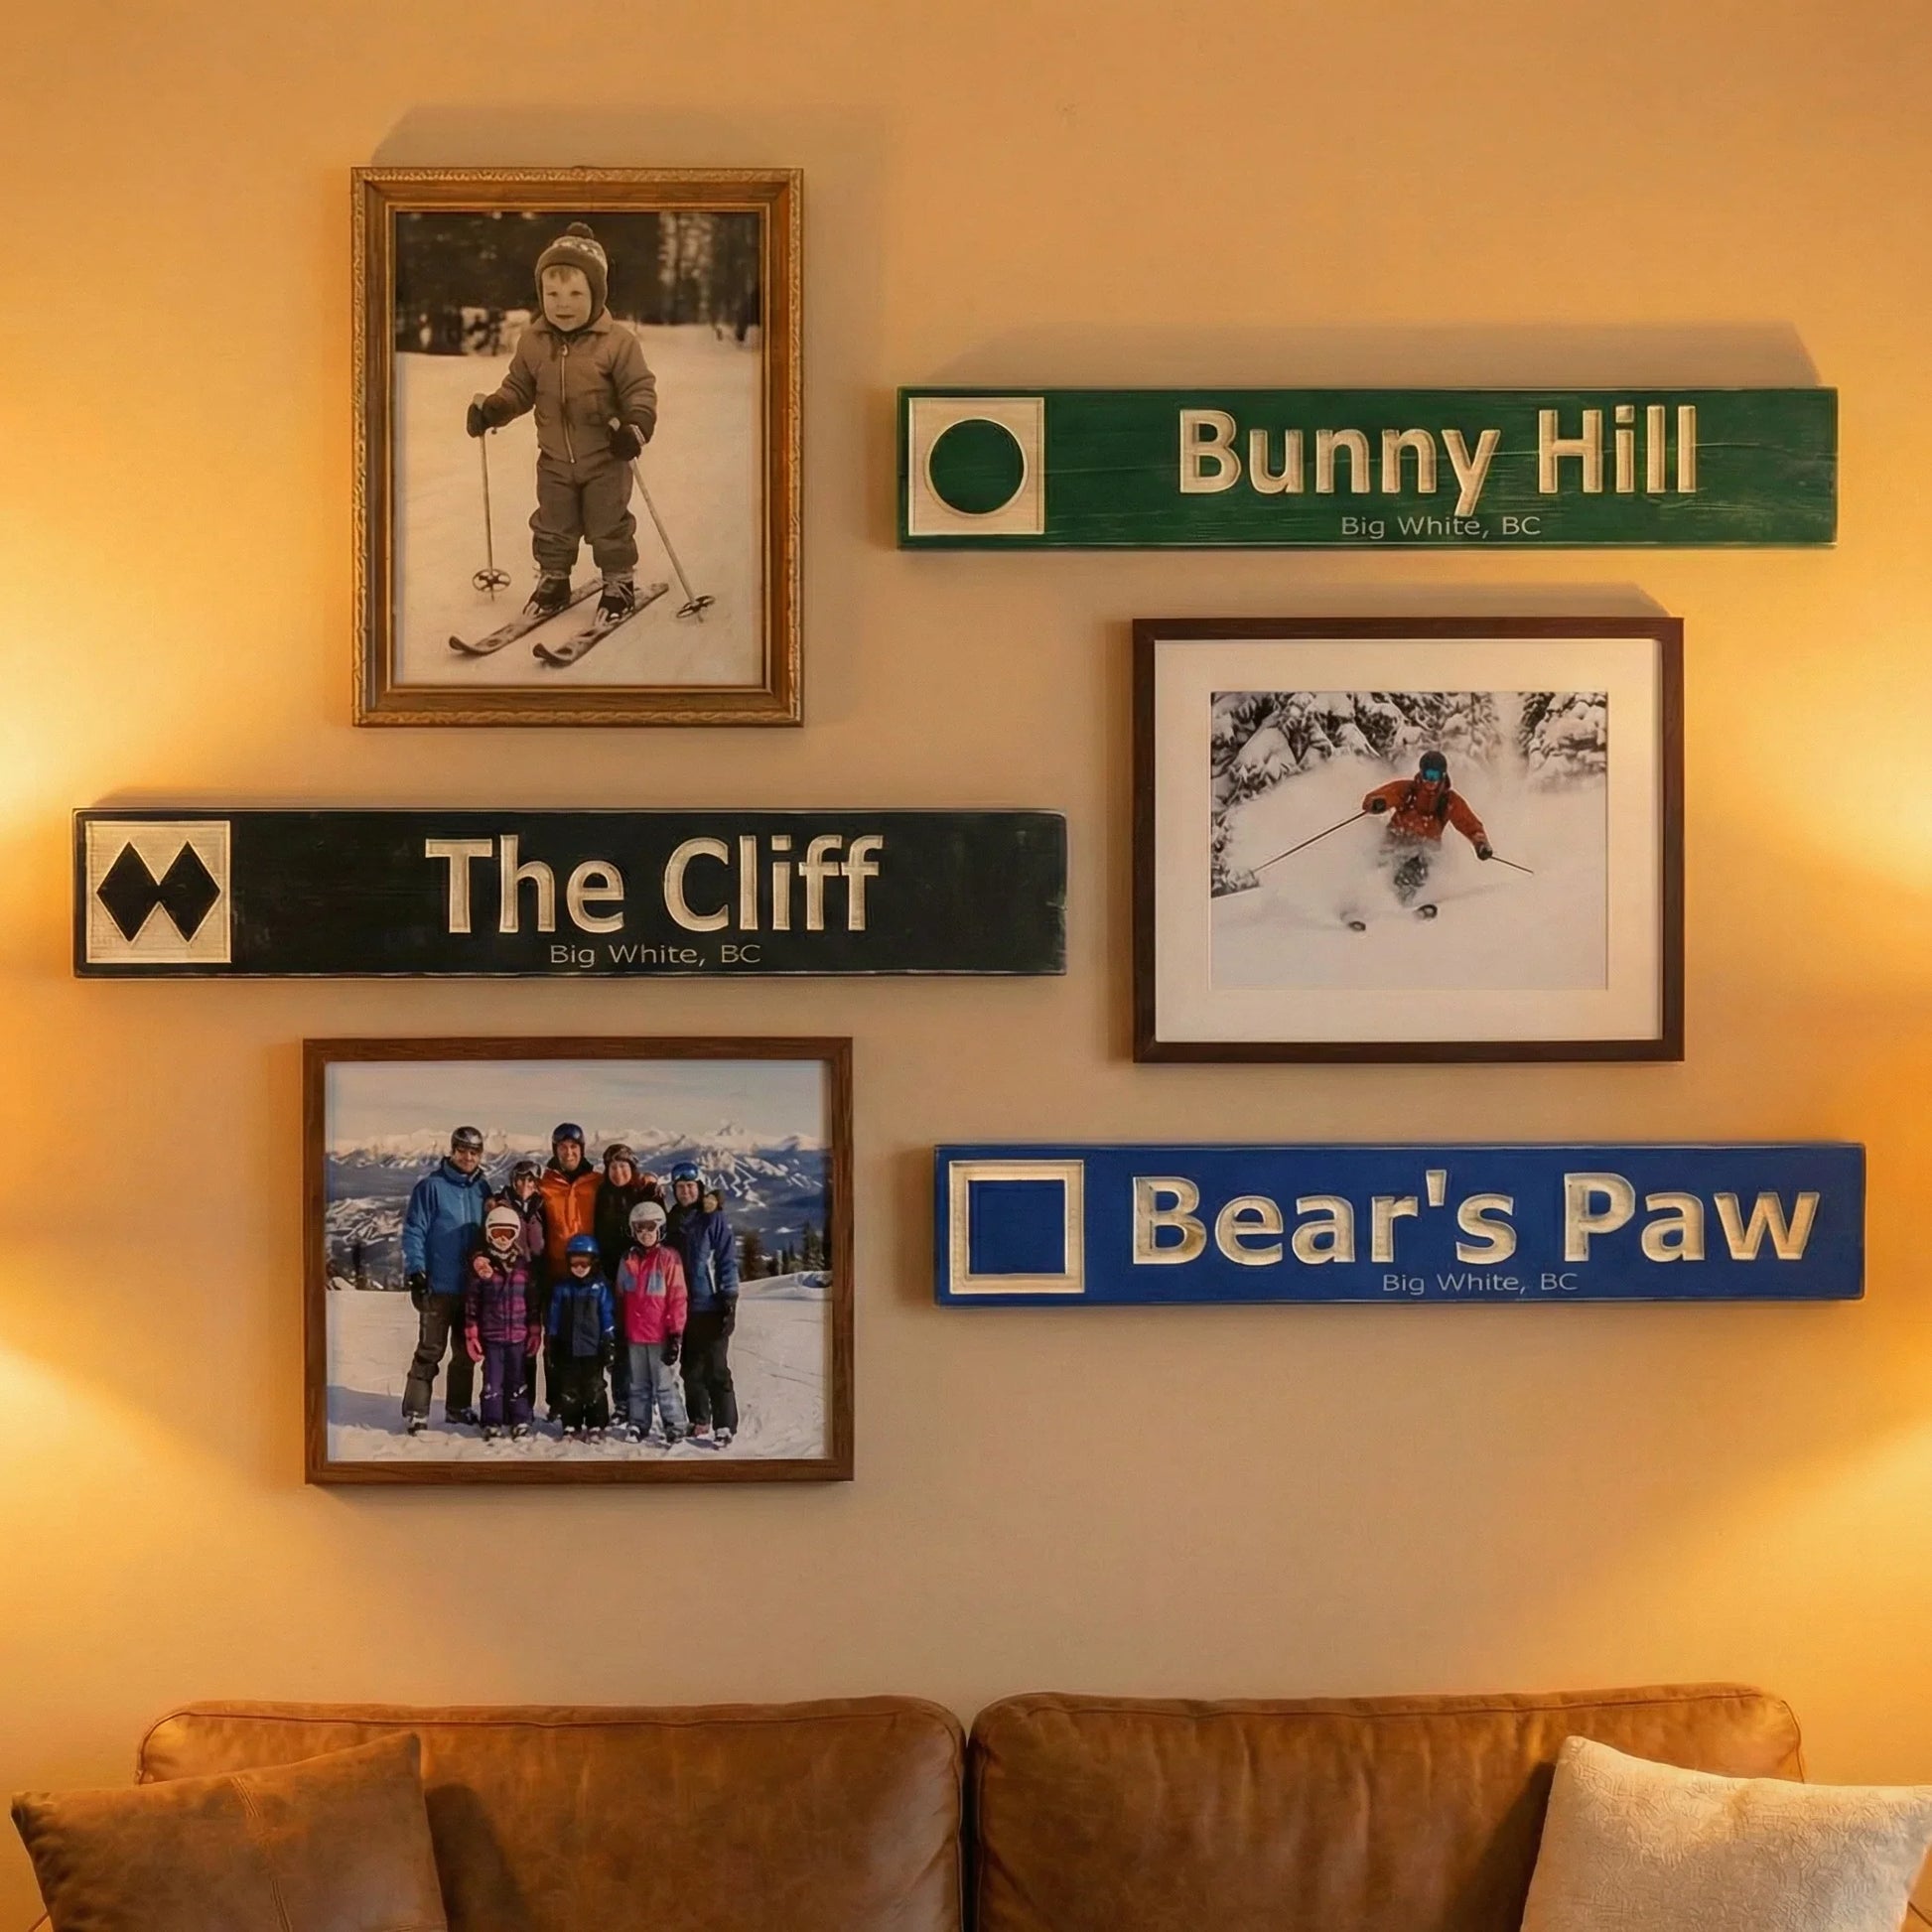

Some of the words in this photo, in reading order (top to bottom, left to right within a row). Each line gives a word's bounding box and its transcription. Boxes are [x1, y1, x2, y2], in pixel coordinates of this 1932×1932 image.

[1177, 408, 1500, 516] Bunny
[1538, 405, 1697, 493] Hill
[1341, 516, 1385, 539] Big
[1398, 516, 1489, 538] White,
[1501, 516, 1541, 535] BC
[424, 834, 624, 933] The
[663, 834, 884, 932] Cliff
[550, 944, 595, 968] Big
[607, 944, 706, 966] White,
[720, 945, 760, 963] BC
[1131, 1170, 1516, 1266] Bear's
[1564, 1172, 1820, 1263] Paw
[1383, 1274, 1425, 1296] Big
[1436, 1274, 1526, 1295] White,
[1541, 1273, 1579, 1291] BC
